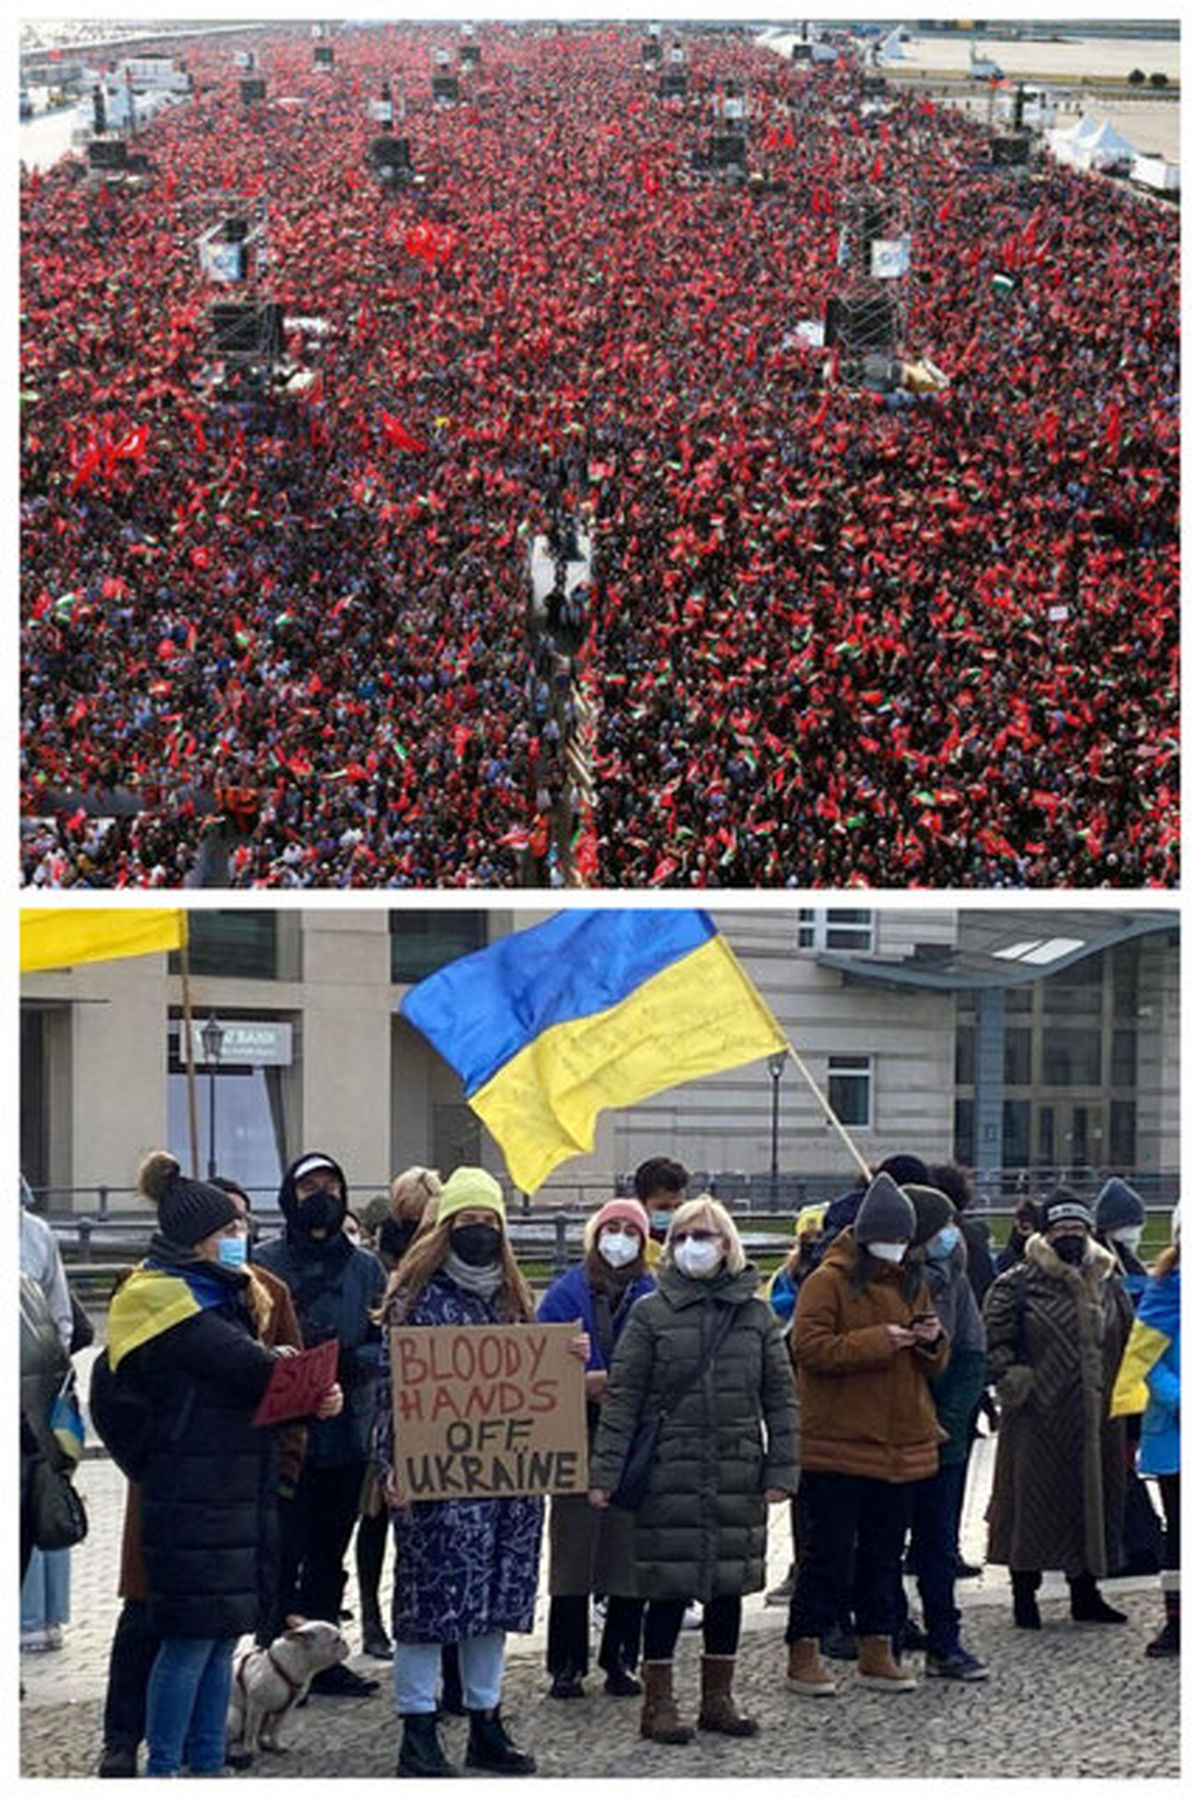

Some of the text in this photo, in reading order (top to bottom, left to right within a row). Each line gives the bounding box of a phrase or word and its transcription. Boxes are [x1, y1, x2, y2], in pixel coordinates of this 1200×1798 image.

[398, 1334, 547, 1386] BLOODY
[399, 1379, 558, 1421] HANDS
[446, 1417, 534, 1452] OFF
